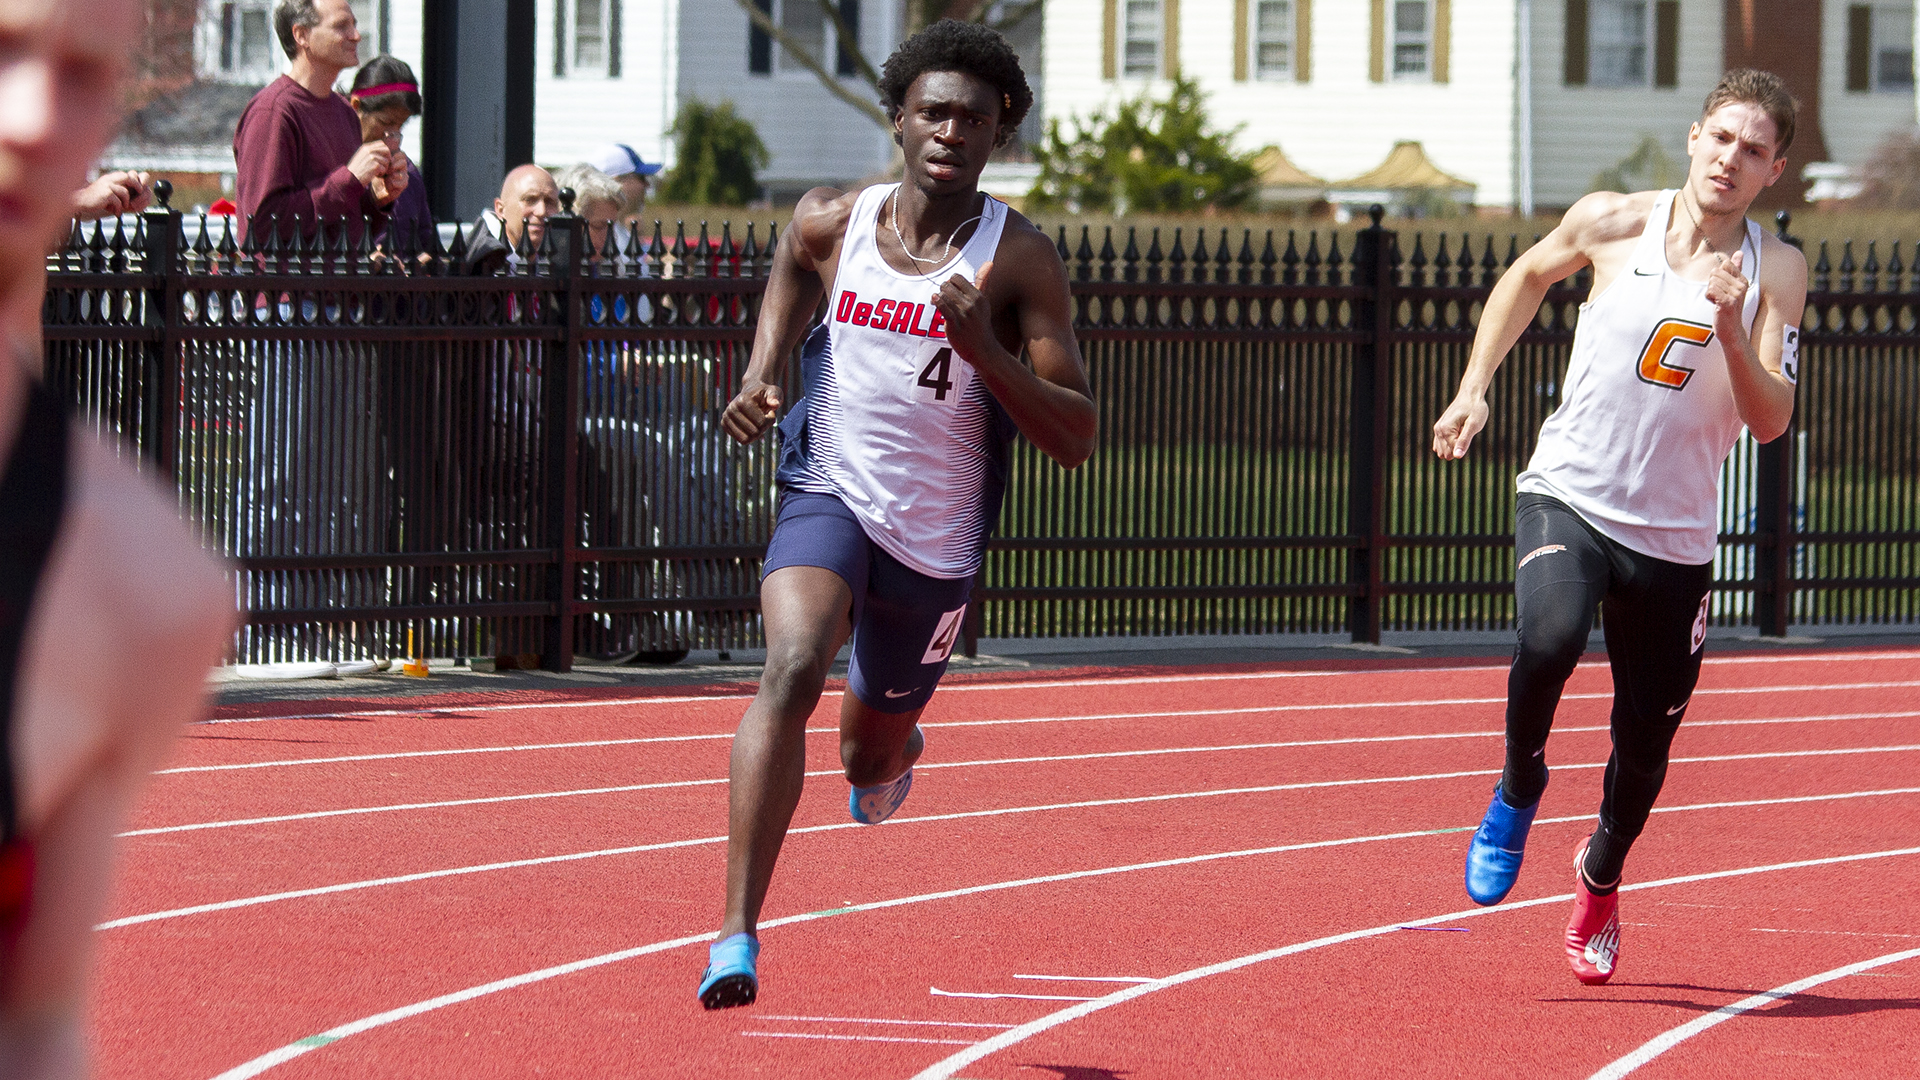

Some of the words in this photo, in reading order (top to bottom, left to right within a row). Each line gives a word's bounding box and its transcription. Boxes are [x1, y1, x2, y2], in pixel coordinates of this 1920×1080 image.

[836, 290, 946, 338] DeSALE
[917, 347, 952, 401] 4
[1636, 317, 1714, 391] C
[931, 611, 962, 658] 4
